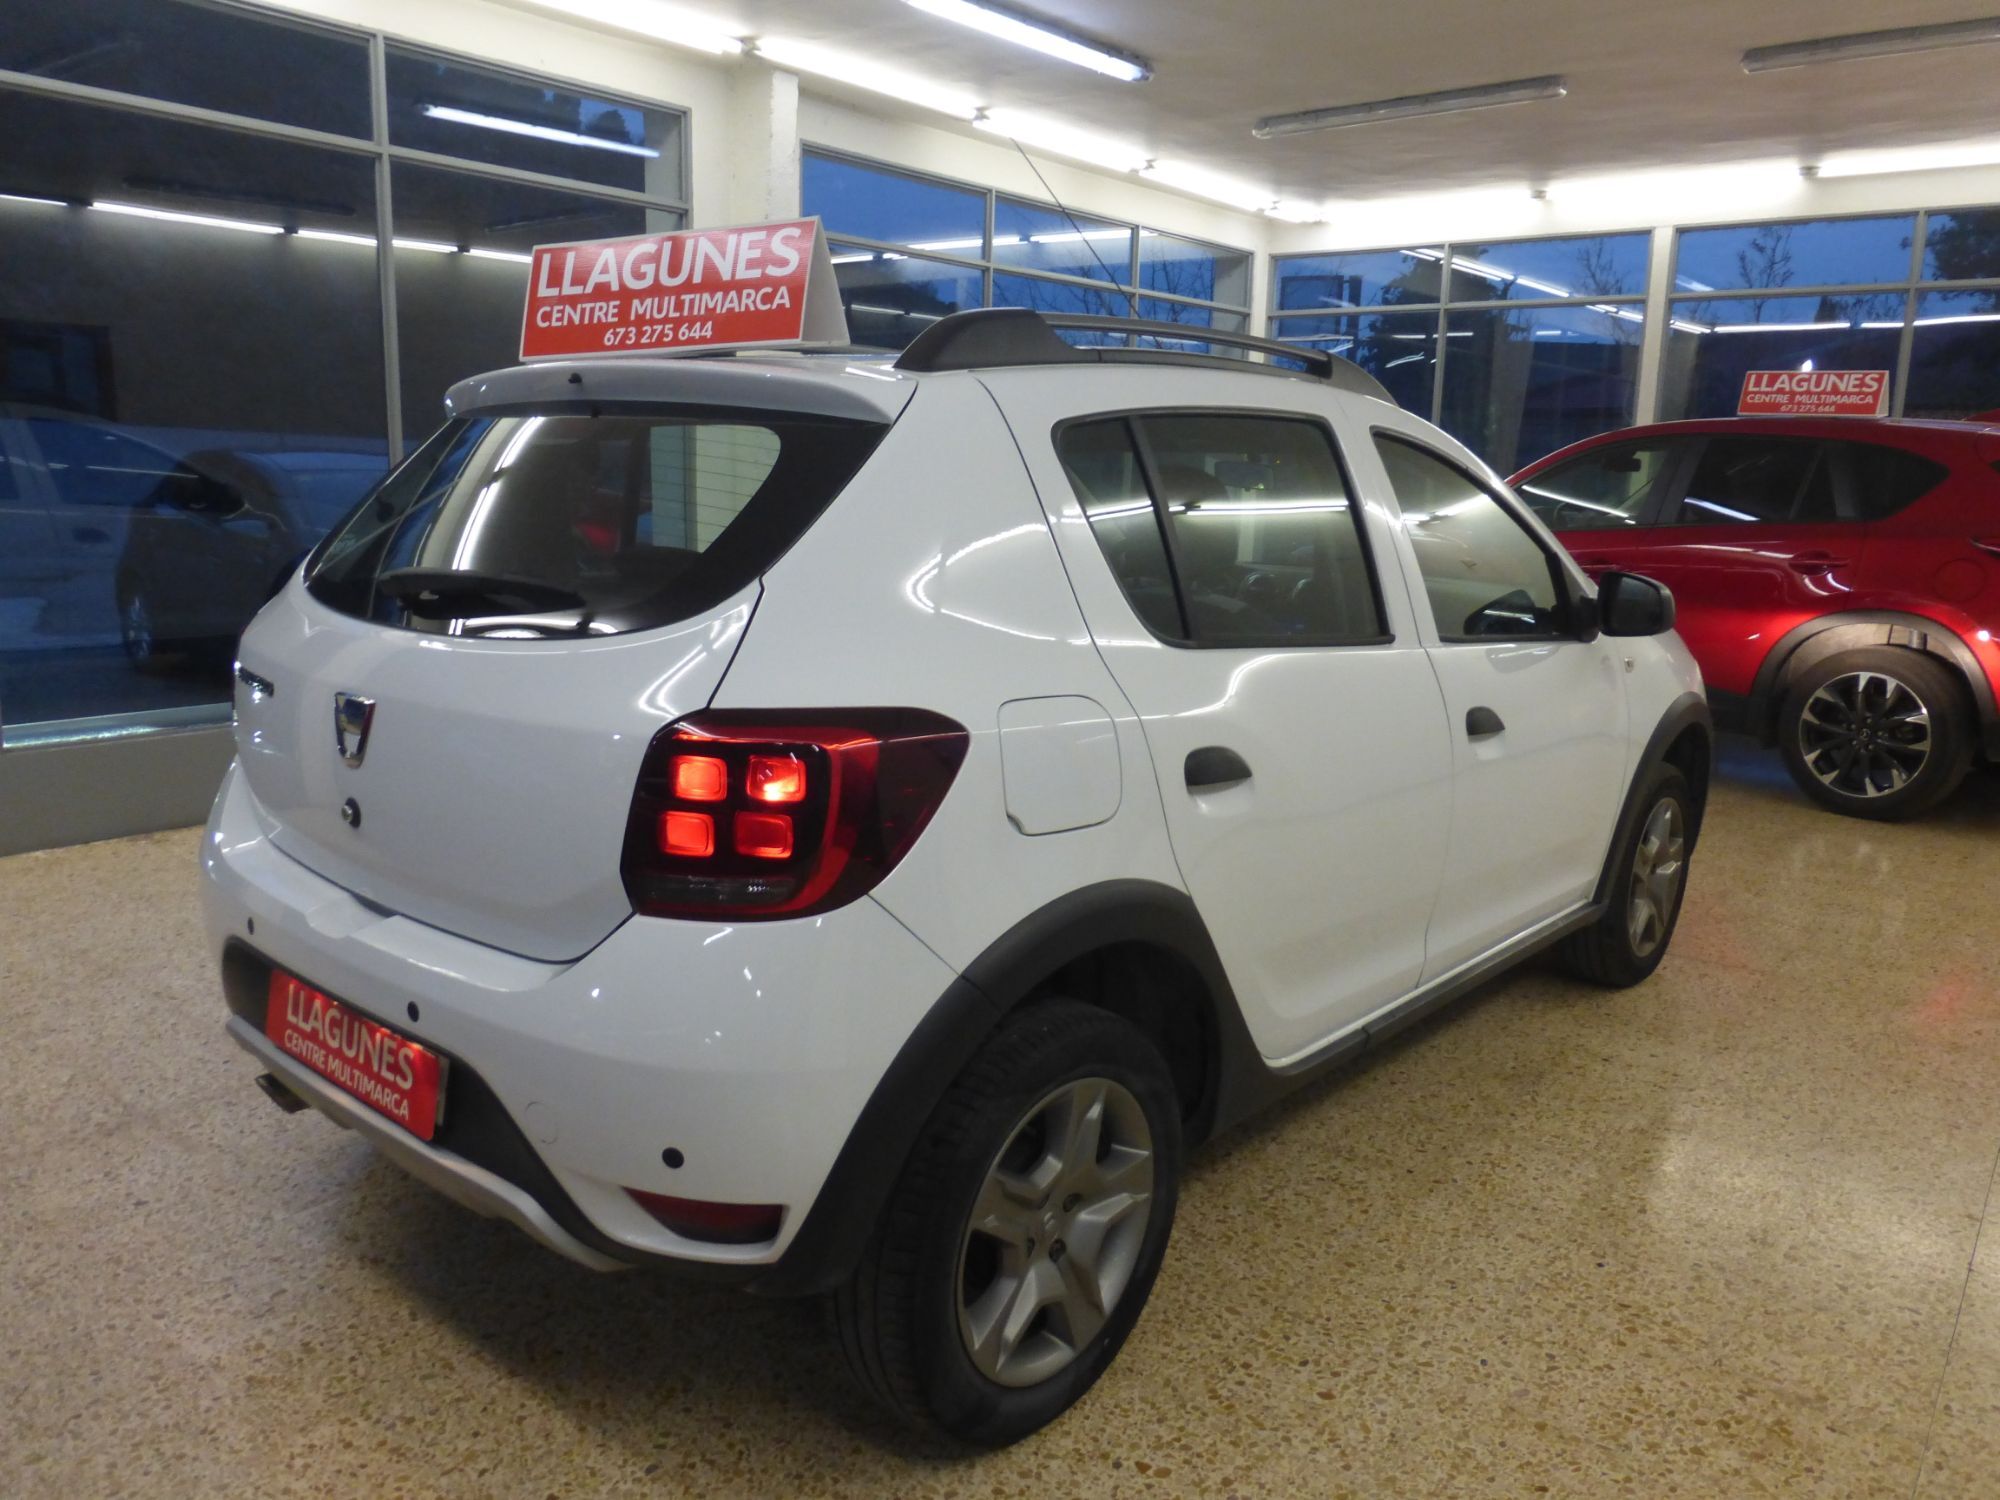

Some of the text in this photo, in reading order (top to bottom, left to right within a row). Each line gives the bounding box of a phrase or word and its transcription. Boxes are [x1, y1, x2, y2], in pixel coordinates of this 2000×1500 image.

[537, 227, 801, 297] LLAGUNES
[536, 286, 791, 328] CENTRE MULTIMARCA
[603, 321, 713, 346] 673 275 644
[1747, 394, 1873, 404] CENTRE MULTIMARCA
[1748, 373, 1880, 392] LLAGUNES
[286, 984, 414, 1090] LLAGUNES
[284, 1029, 410, 1121] CENTRE MULTIMARCA
